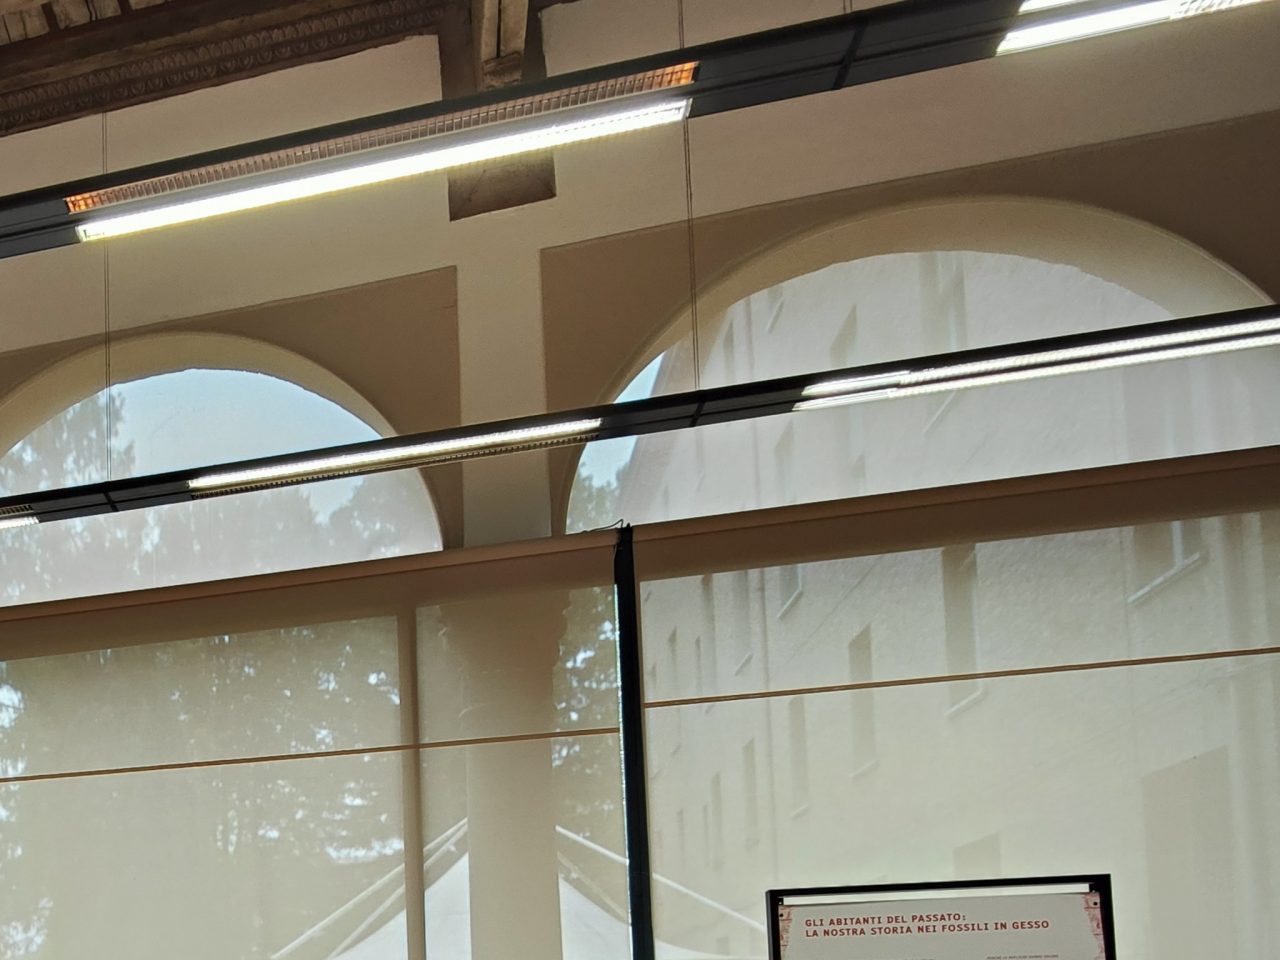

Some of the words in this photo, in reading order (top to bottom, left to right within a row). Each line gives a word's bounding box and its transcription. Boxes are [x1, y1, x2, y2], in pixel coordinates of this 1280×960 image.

[805, 918, 824, 927] GLI
[829, 916, 882, 926] ABITANTI
[887, 915, 908, 924] DEL
[911, 913, 966, 923] PASSATO:
[805, 929, 819, 938] LA
[823, 928, 866, 937] NOSTRA
[870, 926, 913, 936] STORIA
[917, 924, 937, 934] NEI
[941, 922, 989, 932] FOSSILI
[994, 922, 1007, 930] IN
[1012, 920, 1050, 930] GESSO
